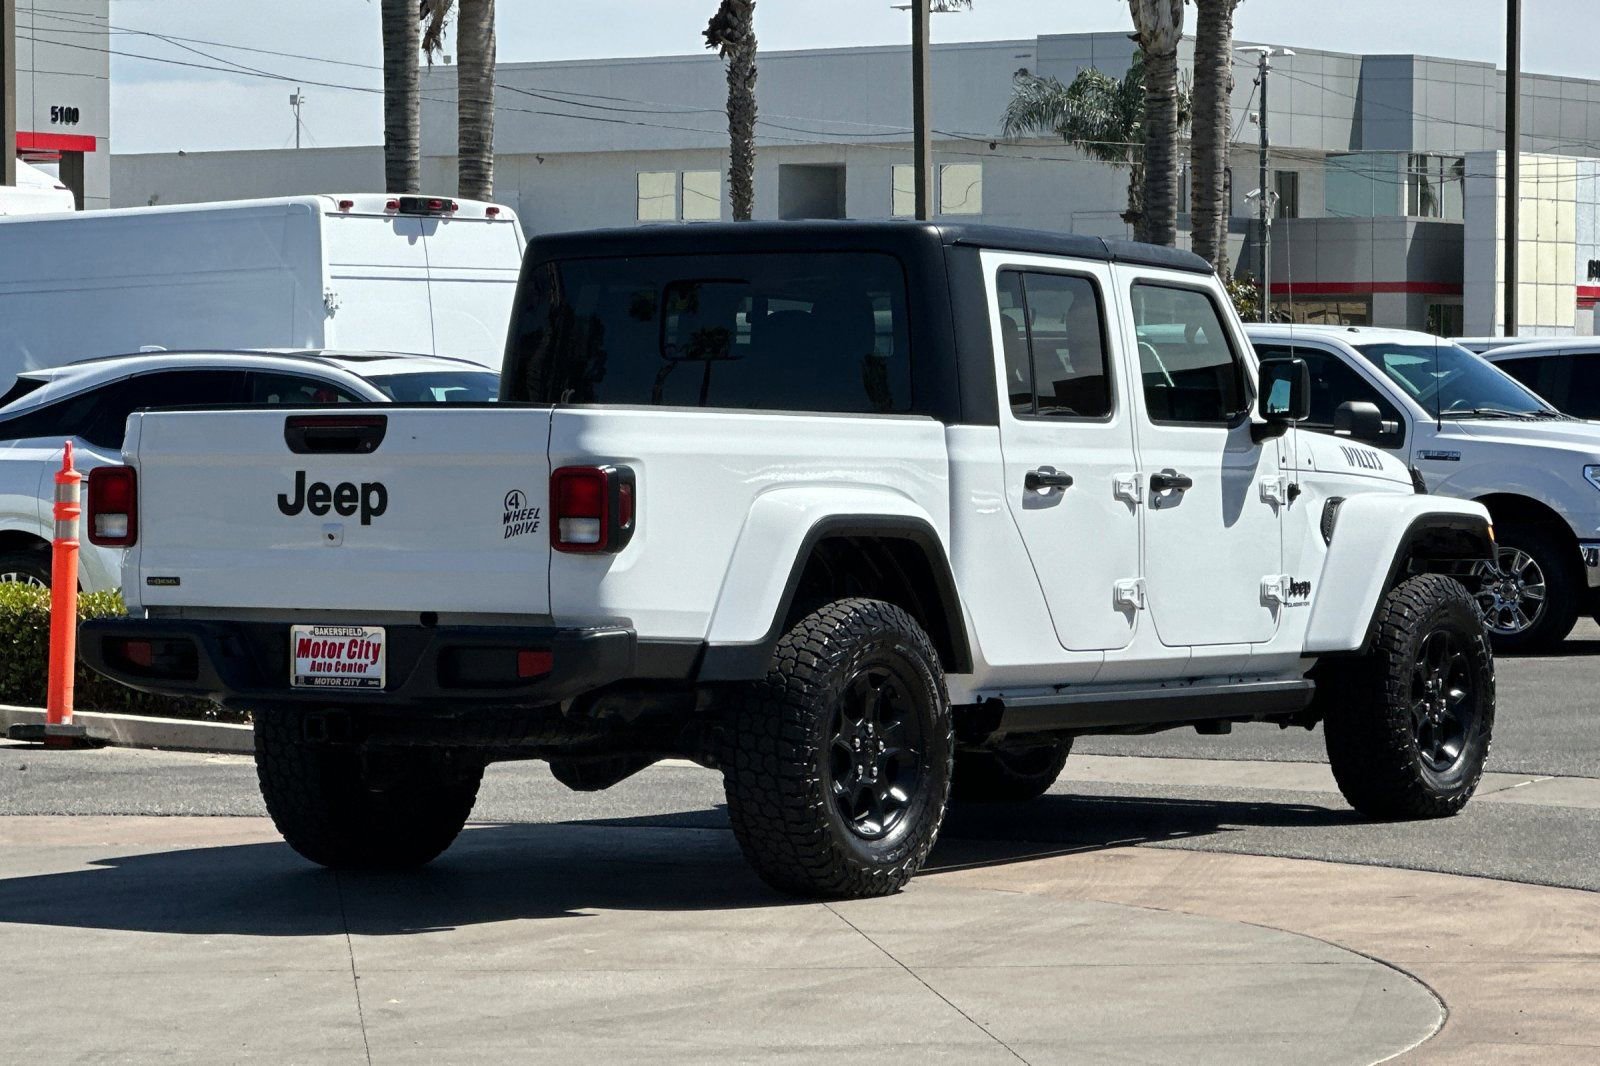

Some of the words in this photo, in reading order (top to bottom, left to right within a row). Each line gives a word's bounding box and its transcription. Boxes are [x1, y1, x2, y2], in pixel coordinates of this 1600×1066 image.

[50, 105, 79, 125] 5100
[1339, 445, 1384, 471] WILLYS
[277, 470, 388, 525] Jeep
[503, 507, 540, 525] WHEEL
[504, 521, 540, 539] DRIVE
[1288, 576, 1311, 600] Jeep
[314, 627, 363, 637] BAKERSFIELD
[296, 638, 345, 659] Motor
[346, 638, 382, 665] City
[309, 660, 333, 673] Auto
[334, 660, 369, 673] Center
[313, 677, 341, 686] MOTOR
[342, 678, 362, 687] CITY
